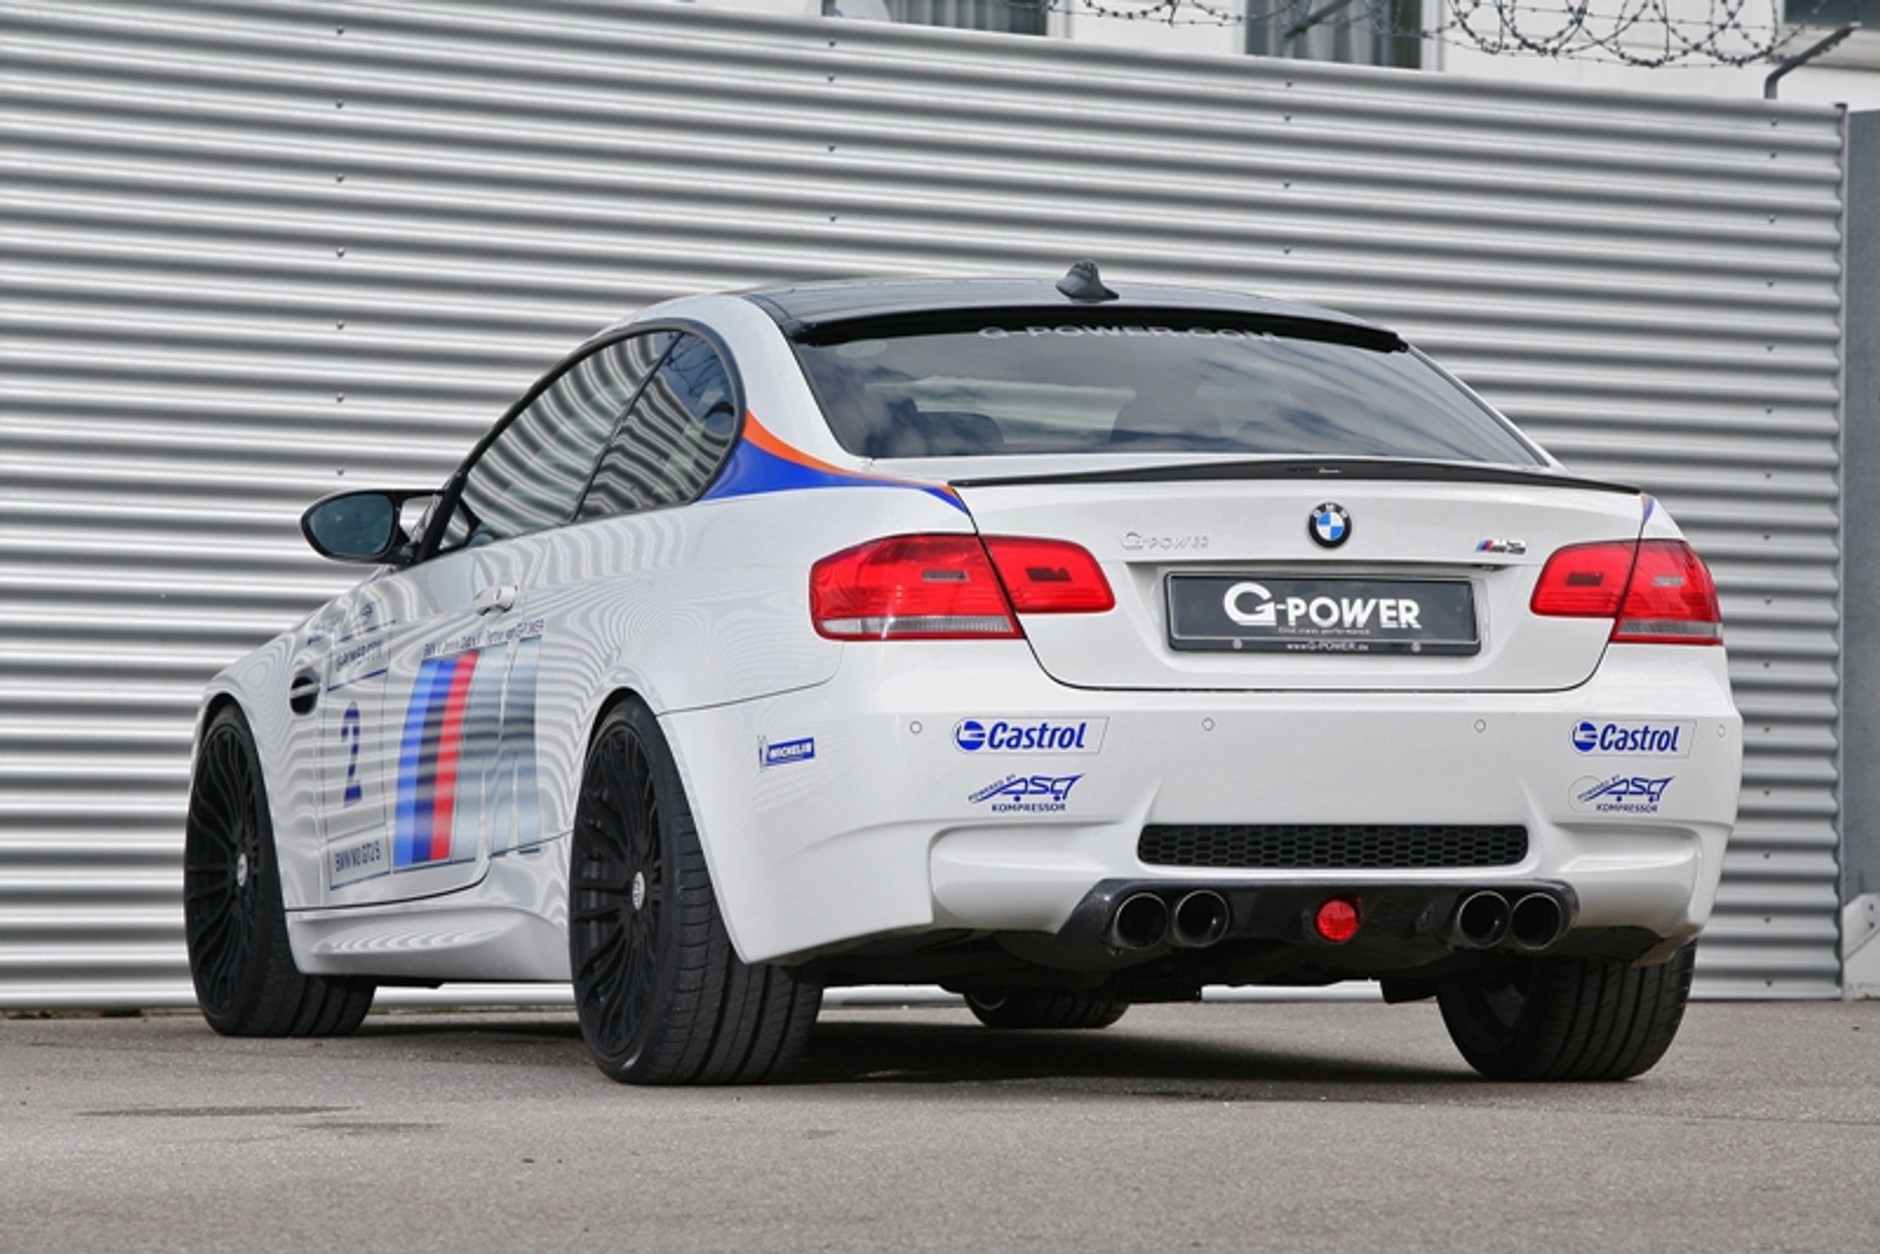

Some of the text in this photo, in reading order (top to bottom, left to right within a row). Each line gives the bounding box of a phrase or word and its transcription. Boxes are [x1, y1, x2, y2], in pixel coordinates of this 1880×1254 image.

[1222, 581, 1423, 628] G-POWER
[988, 721, 1087, 749] Castrol
[1600, 723, 1679, 751] Castrol
[341, 701, 362, 808] 2
[991, 803, 1066, 812] KOMPRESSOR
[1596, 803, 1658, 812] KOMPRESSOR
